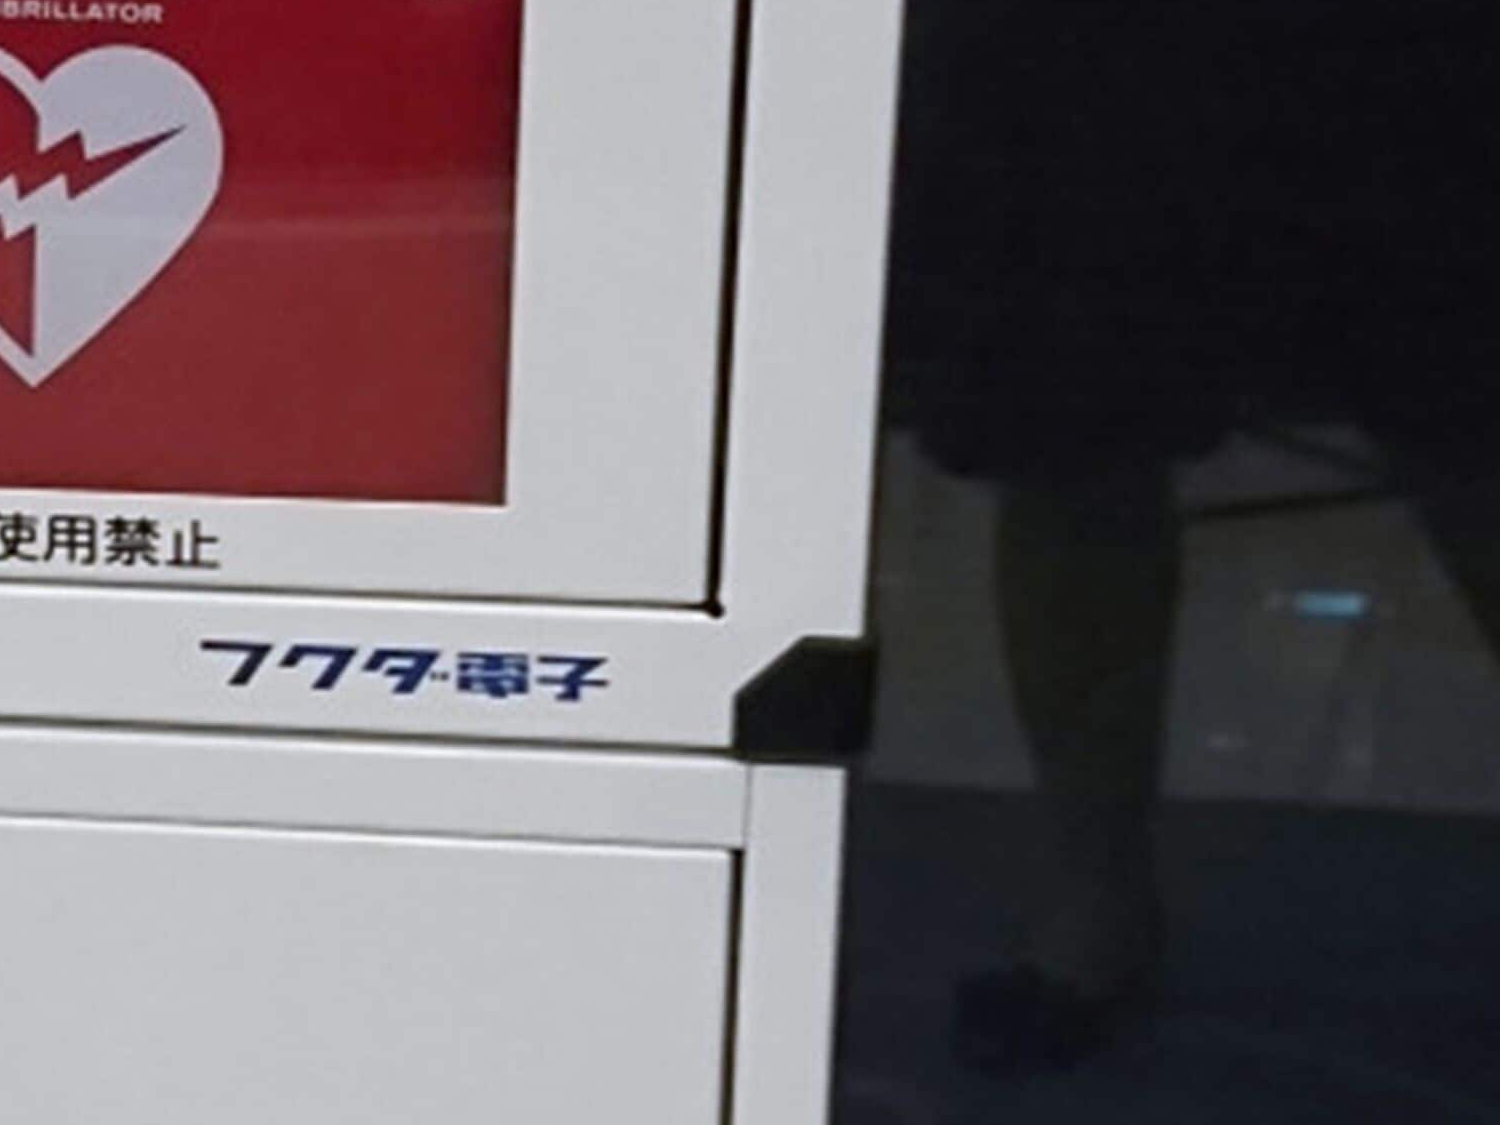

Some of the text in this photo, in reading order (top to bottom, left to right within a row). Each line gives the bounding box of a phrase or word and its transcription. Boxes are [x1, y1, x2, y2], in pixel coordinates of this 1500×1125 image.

[199, 639, 609, 703] フクダ電子
